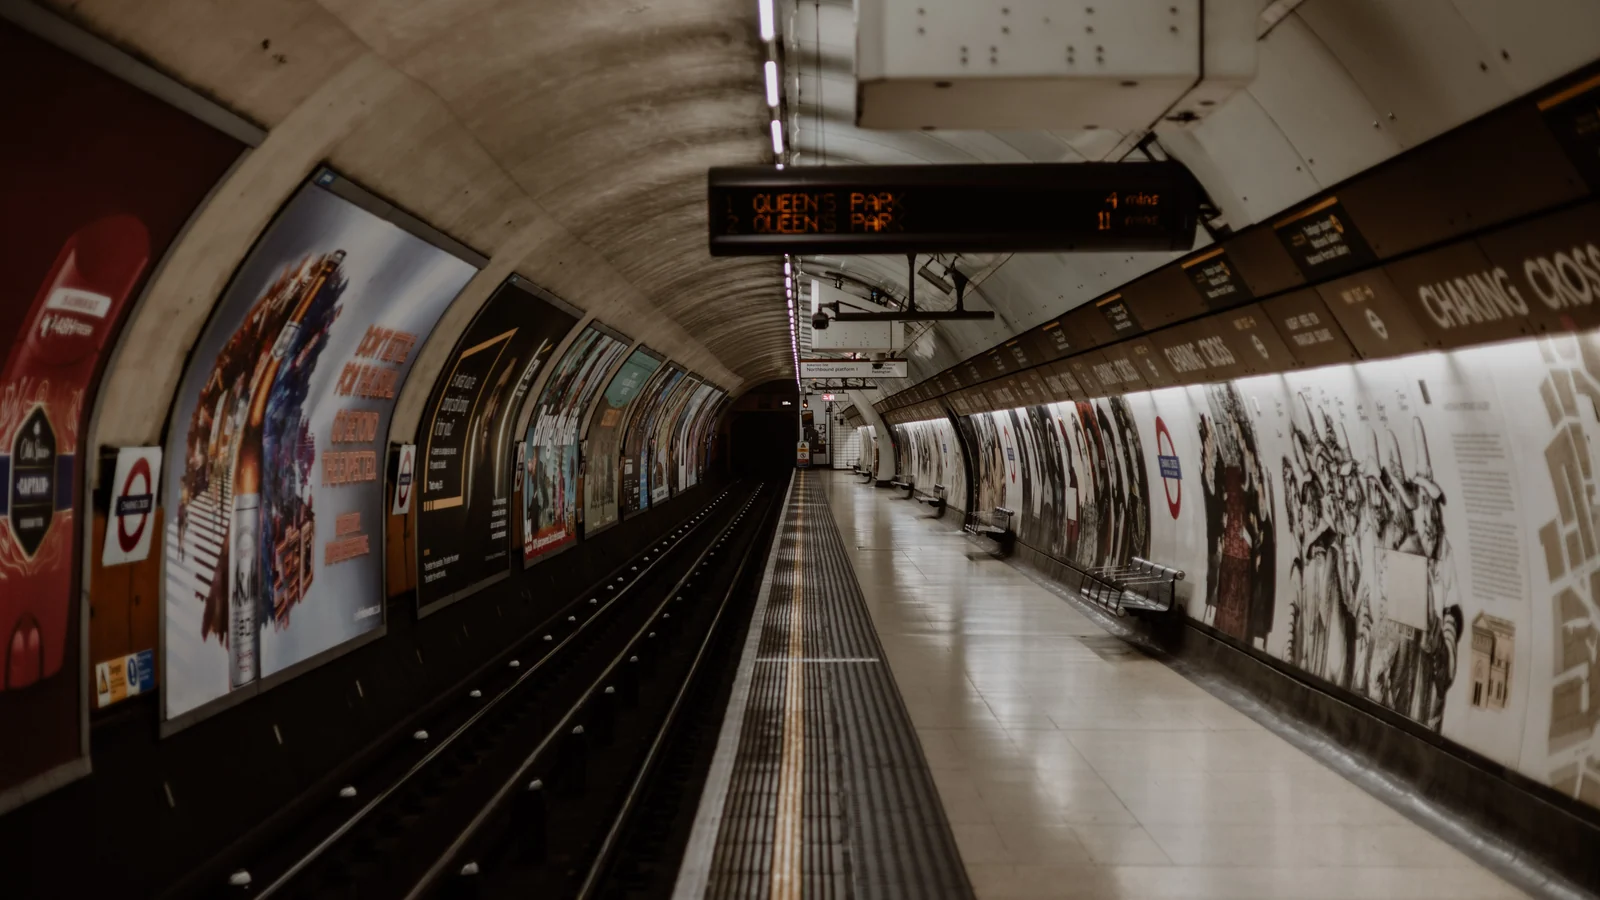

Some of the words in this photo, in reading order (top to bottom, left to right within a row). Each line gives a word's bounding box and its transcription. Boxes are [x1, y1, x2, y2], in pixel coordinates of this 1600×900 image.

[850, 192, 906, 213] PARK
[1104, 191, 1119, 209] 4
[1125, 191, 1159, 206] mins
[850, 213, 905, 233] PARK
[1097, 210, 1111, 230] 11
[1418, 266, 1530, 329] CHARING
[1164, 342, 1208, 374] CHARING
[1197, 335, 1237, 368] CROSS
